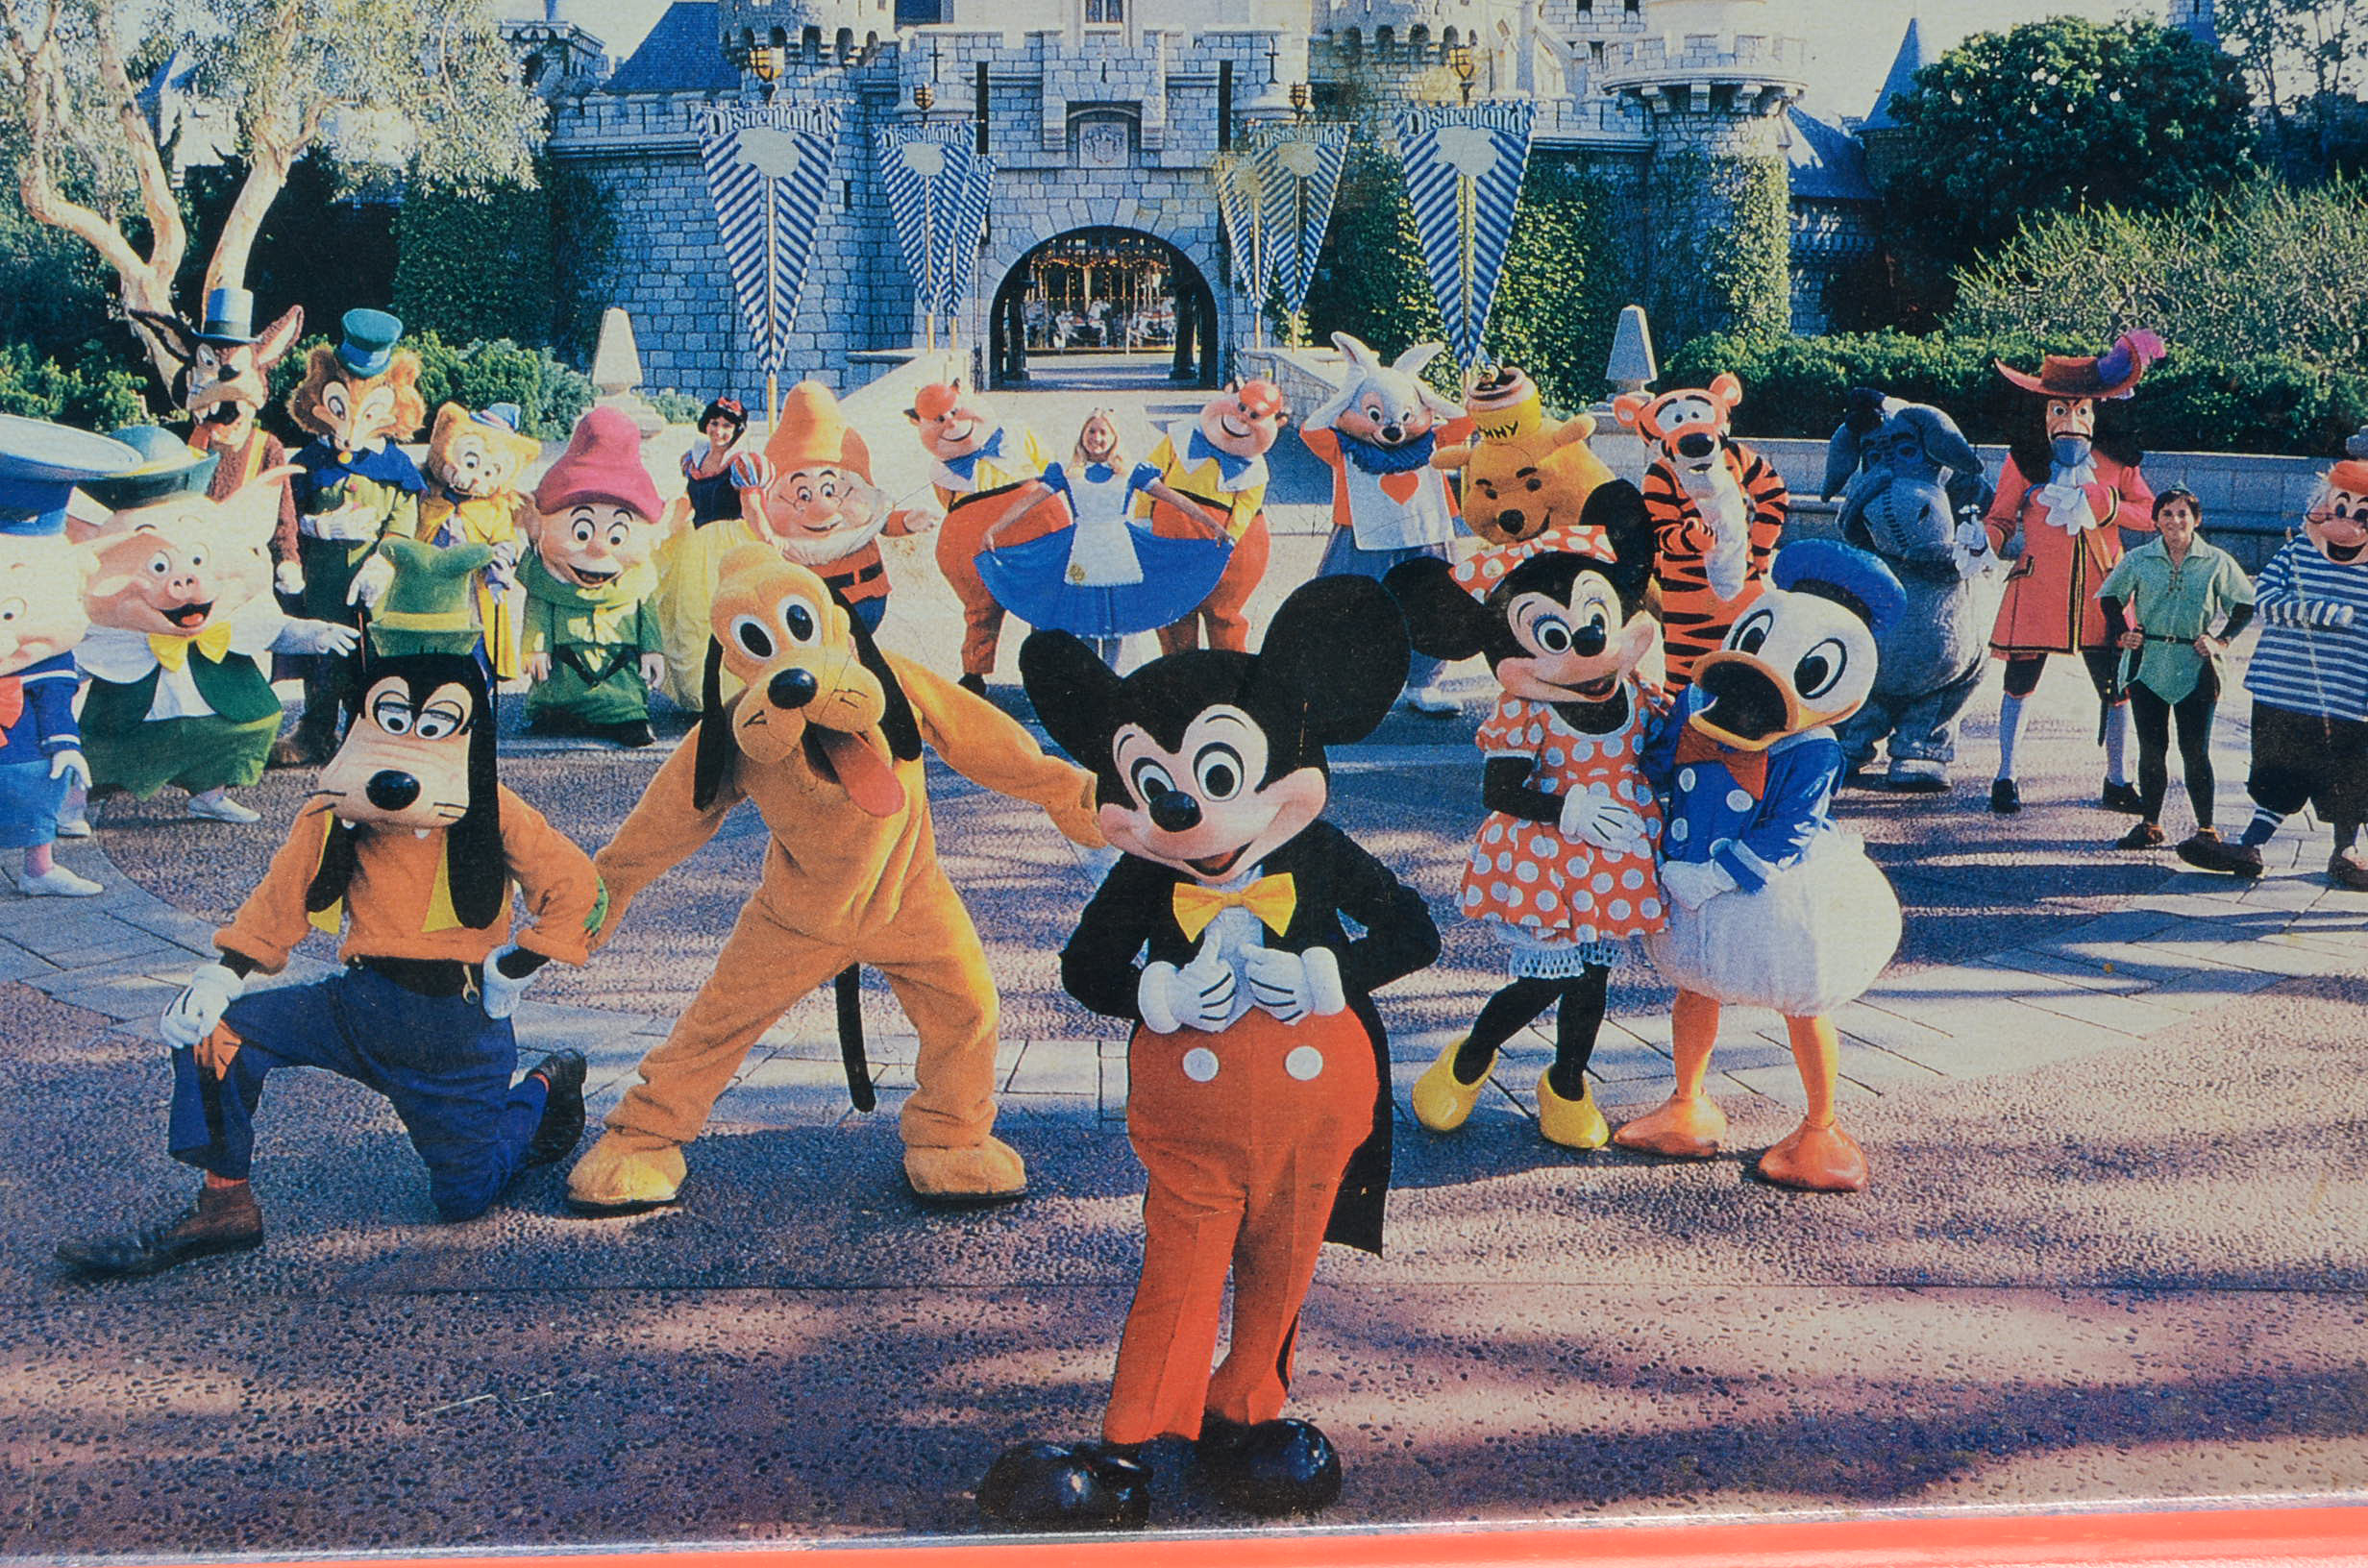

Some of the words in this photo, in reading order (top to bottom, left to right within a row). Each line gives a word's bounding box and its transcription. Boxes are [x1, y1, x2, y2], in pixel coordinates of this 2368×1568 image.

[703, 103, 831, 137] Disneyland
[1401, 102, 1531, 136] Disneyland
[879, 125, 967, 148] Disneyland
